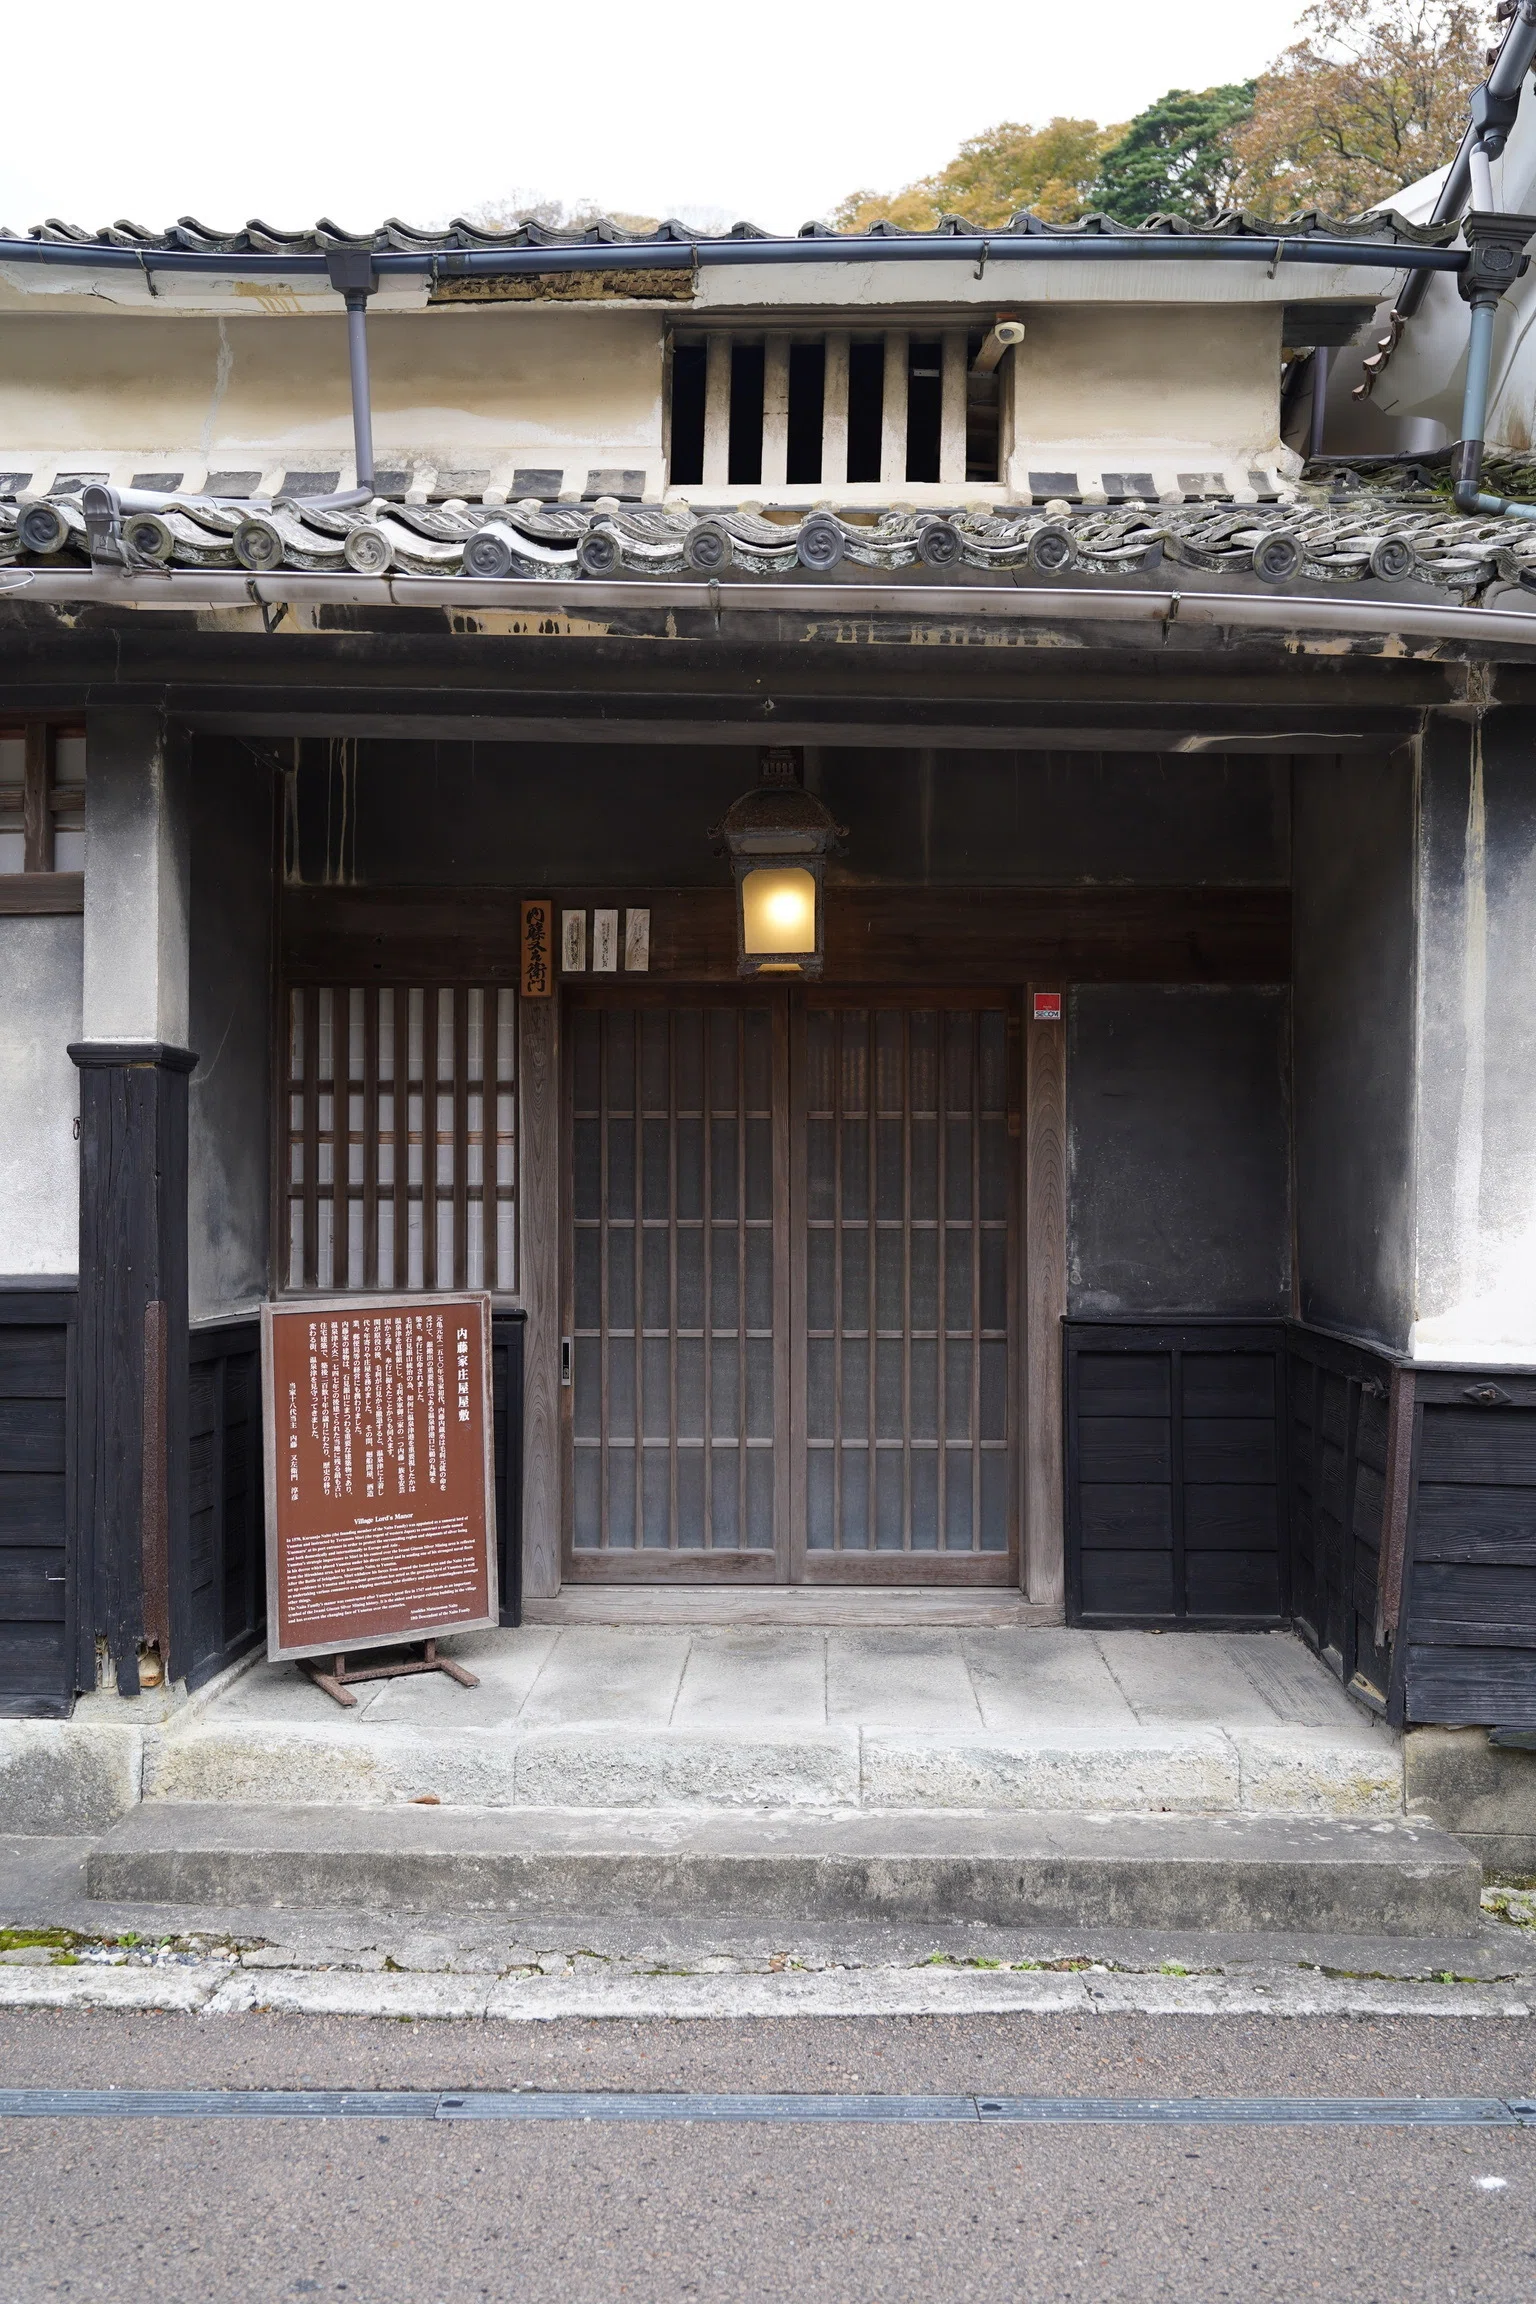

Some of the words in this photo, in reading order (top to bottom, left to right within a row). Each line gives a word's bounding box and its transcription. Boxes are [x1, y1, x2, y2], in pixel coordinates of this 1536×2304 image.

[457, 1328, 469, 1421] 内藤家庄屋屋敷
[375, 1514, 394, 1522] Lord's
